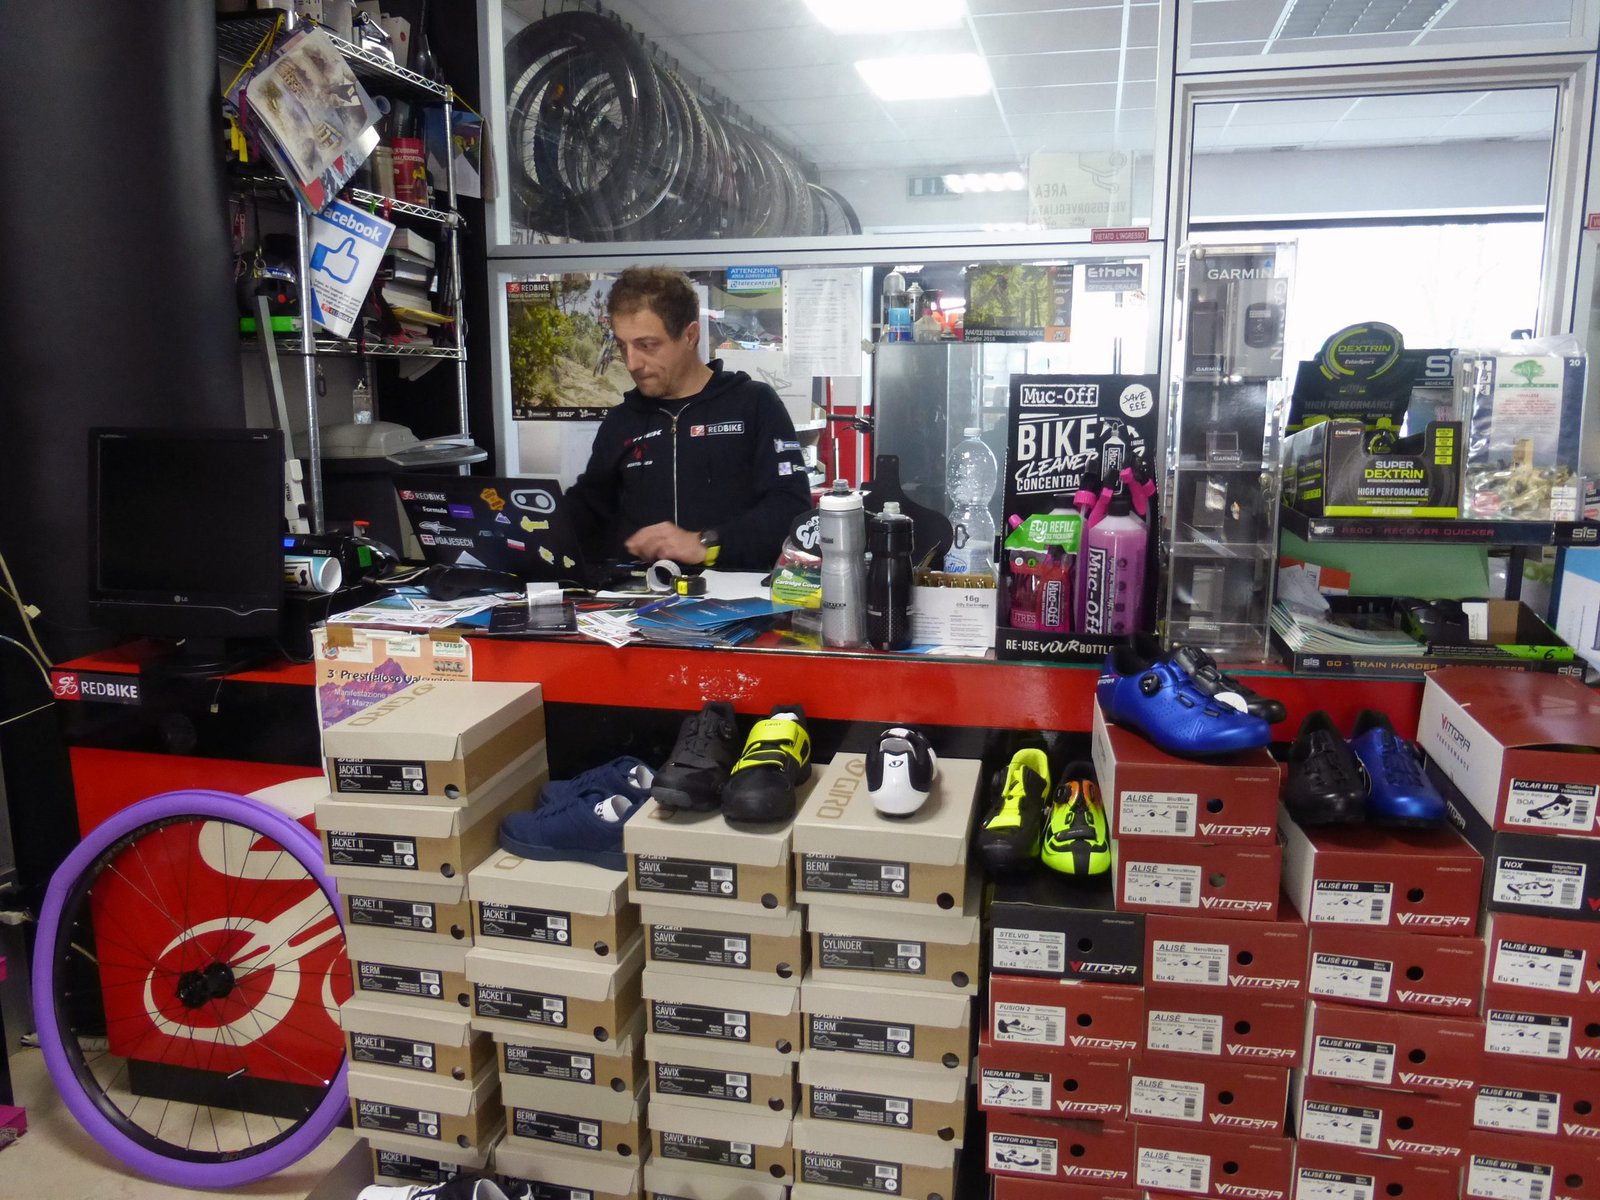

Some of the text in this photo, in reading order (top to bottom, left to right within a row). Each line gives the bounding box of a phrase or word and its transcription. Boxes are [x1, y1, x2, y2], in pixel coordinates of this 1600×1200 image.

[321, 205, 383, 243] acebook
[1094, 232, 1145, 240] VIETATO L'INGRESSO
[1087, 266, 1138, 278] EtheN
[1208, 268, 1274, 280] GARMIN
[521, 284, 550, 292] REDBIKE
[1338, 344, 1392, 352] DEXTRIN
[1024, 387, 1096, 405] Muc-Off
[1122, 390, 1147, 404] SAVE
[1130, 400, 1147, 412] £££
[1328, 400, 1394, 409] PERFORMANCE
[708, 424, 742, 433] REDBIKE
[1018, 418, 1098, 462] BIKE
[1375, 460, 1414, 469] SUPER
[1364, 470, 1424, 479] DEXTRIN
[1016, 473, 1083, 492] CONCENTRA
[414, 492, 446, 502] REDBIKE
[1358, 488, 1429, 496] HIGH PERFORMANCE
[422, 506, 448, 514] Formula
[1030, 519, 1075, 532] ECO REFILL
[1444, 528, 1495, 536] QUICKER
[802, 581, 821, 590] Cover
[964, 594, 980, 603] 16g
[1086, 552, 1100, 634] Muc-Off
[1048, 582, 1058, 626] Muc-Off
[1006, 640, 1038, 651] RE-USE
[1039, 639, 1080, 653] YOUR
[1326, 659, 1342, 668] GO
[1352, 660, 1388, 669] TRAIN
[1391, 662, 1438, 672] HARDER
[340, 670, 401, 684] Prestigioso
[80, 680, 138, 698] REDBIKE
[334, 688, 386, 699] Manifestazione
[1441, 712, 1472, 752] VITTORIA
[1436, 734, 1470, 772] PERFORMANCE
[339, 766, 363, 774] JACKET
[1514, 781, 1542, 790] POLAR
[816, 778, 859, 820] GIRO
[1126, 794, 1154, 802] ALISÉ
[1199, 822, 1272, 838] VITTORIA
[332, 838, 356, 848] JACKET
[638, 862, 660, 872] SAVIX
[806, 862, 830, 872] BERM
[1130, 864, 1158, 873] ALISÉ
[1504, 861, 1524, 869] NOX
[1318, 882, 1358, 890] ALISÉ MTB
[352, 898, 376, 908] JACKET
[1200, 896, 1273, 912] VITTORIA
[482, 909, 508, 920] JACKET
[1396, 912, 1470, 928] VITTORIA
[654, 932, 676, 943] SAVIX
[1000, 932, 1030, 940] STELVIO
[822, 940, 862, 950] CYLINDER
[1158, 944, 1186, 952] ALISÉ
[1502, 942, 1547, 954] ALISÉ MTB
[1317, 955, 1358, 967] ALISÉ MTB
[361, 965, 380, 974] BERM
[1070, 960, 1138, 975] VITTORIA
[1228, 974, 1300, 990] VITTORIA
[478, 990, 504, 1000] JACKET
[1396, 990, 1472, 1008] VITTORIA
[655, 1006, 676, 1016] SAVIX
[1000, 1004, 1024, 1012] FUSION
[1154, 1014, 1181, 1022] ALISÉ
[1492, 1012, 1534, 1022] ALISÉ MTB
[813, 1020, 836, 1031] BERM
[354, 1036, 378, 1046] JACKET
[1070, 1036, 1137, 1050] VITTORIA
[1320, 1038, 1362, 1050] ALISÉ MTB
[508, 1048, 528, 1058] BERM
[1226, 1043, 1296, 1058] VITTORIA
[658, 1066, 680, 1076] SAVIX
[1136, 1080, 1163, 1088] ALISÉ
[1398, 1072, 1474, 1090] VITTORIA
[814, 1091, 836, 1102] BERM
[1480, 1088, 1523, 1098] ALISÉ MTB
[360, 1103, 384, 1114] JACKET
[1056, 1100, 1122, 1114] VITTORIA
[1307, 1102, 1348, 1114] ALISÉ MTB
[516, 1110, 536, 1121] BERM
[1209, 1112, 1279, 1130] VITTORIA
[664, 1132, 684, 1143] SAVIX
[993, 1135, 1019, 1144] CAPTOR
[1386, 1138, 1462, 1156] VITTORIA
[380, 1152, 404, 1162] JACKET
[1144, 1152, 1170, 1160] ALISÉ
[804, 1156, 842, 1168] CYLINDER
[1475, 1158, 1518, 1170] ALISÉ MTB
[1062, 1164, 1128, 1180] VITTORIA
[1302, 1170, 1342, 1181] ALISÉ MTB
[1214, 1182, 1284, 1200] VITTORIA
